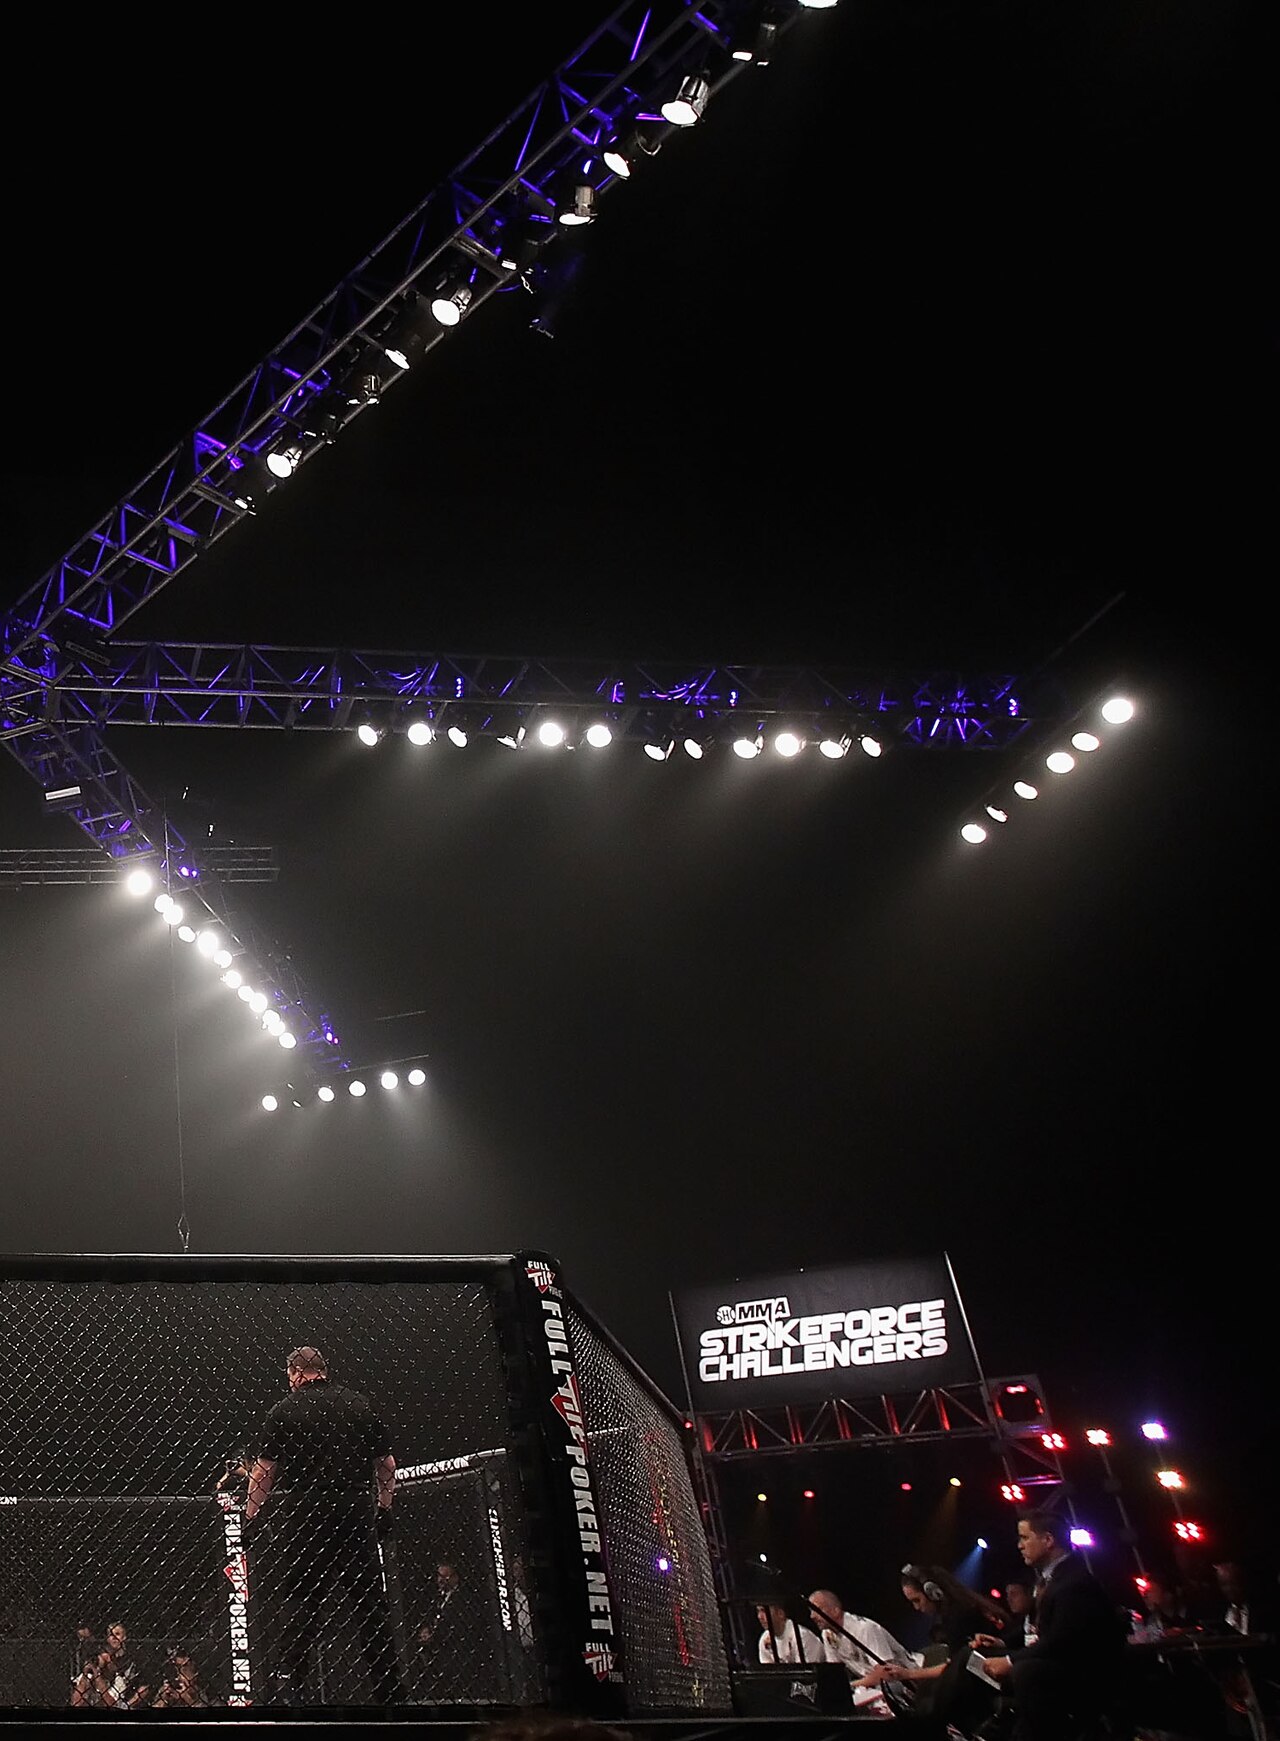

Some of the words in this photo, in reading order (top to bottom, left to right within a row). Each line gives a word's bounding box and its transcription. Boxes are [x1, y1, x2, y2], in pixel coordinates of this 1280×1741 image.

[527, 1261, 550, 1270] FULL
[699, 1299, 946, 1357] STRIKEFORCE
[739, 1301, 787, 1321] MMA
[699, 1328, 949, 1383] CHALLENGERS
